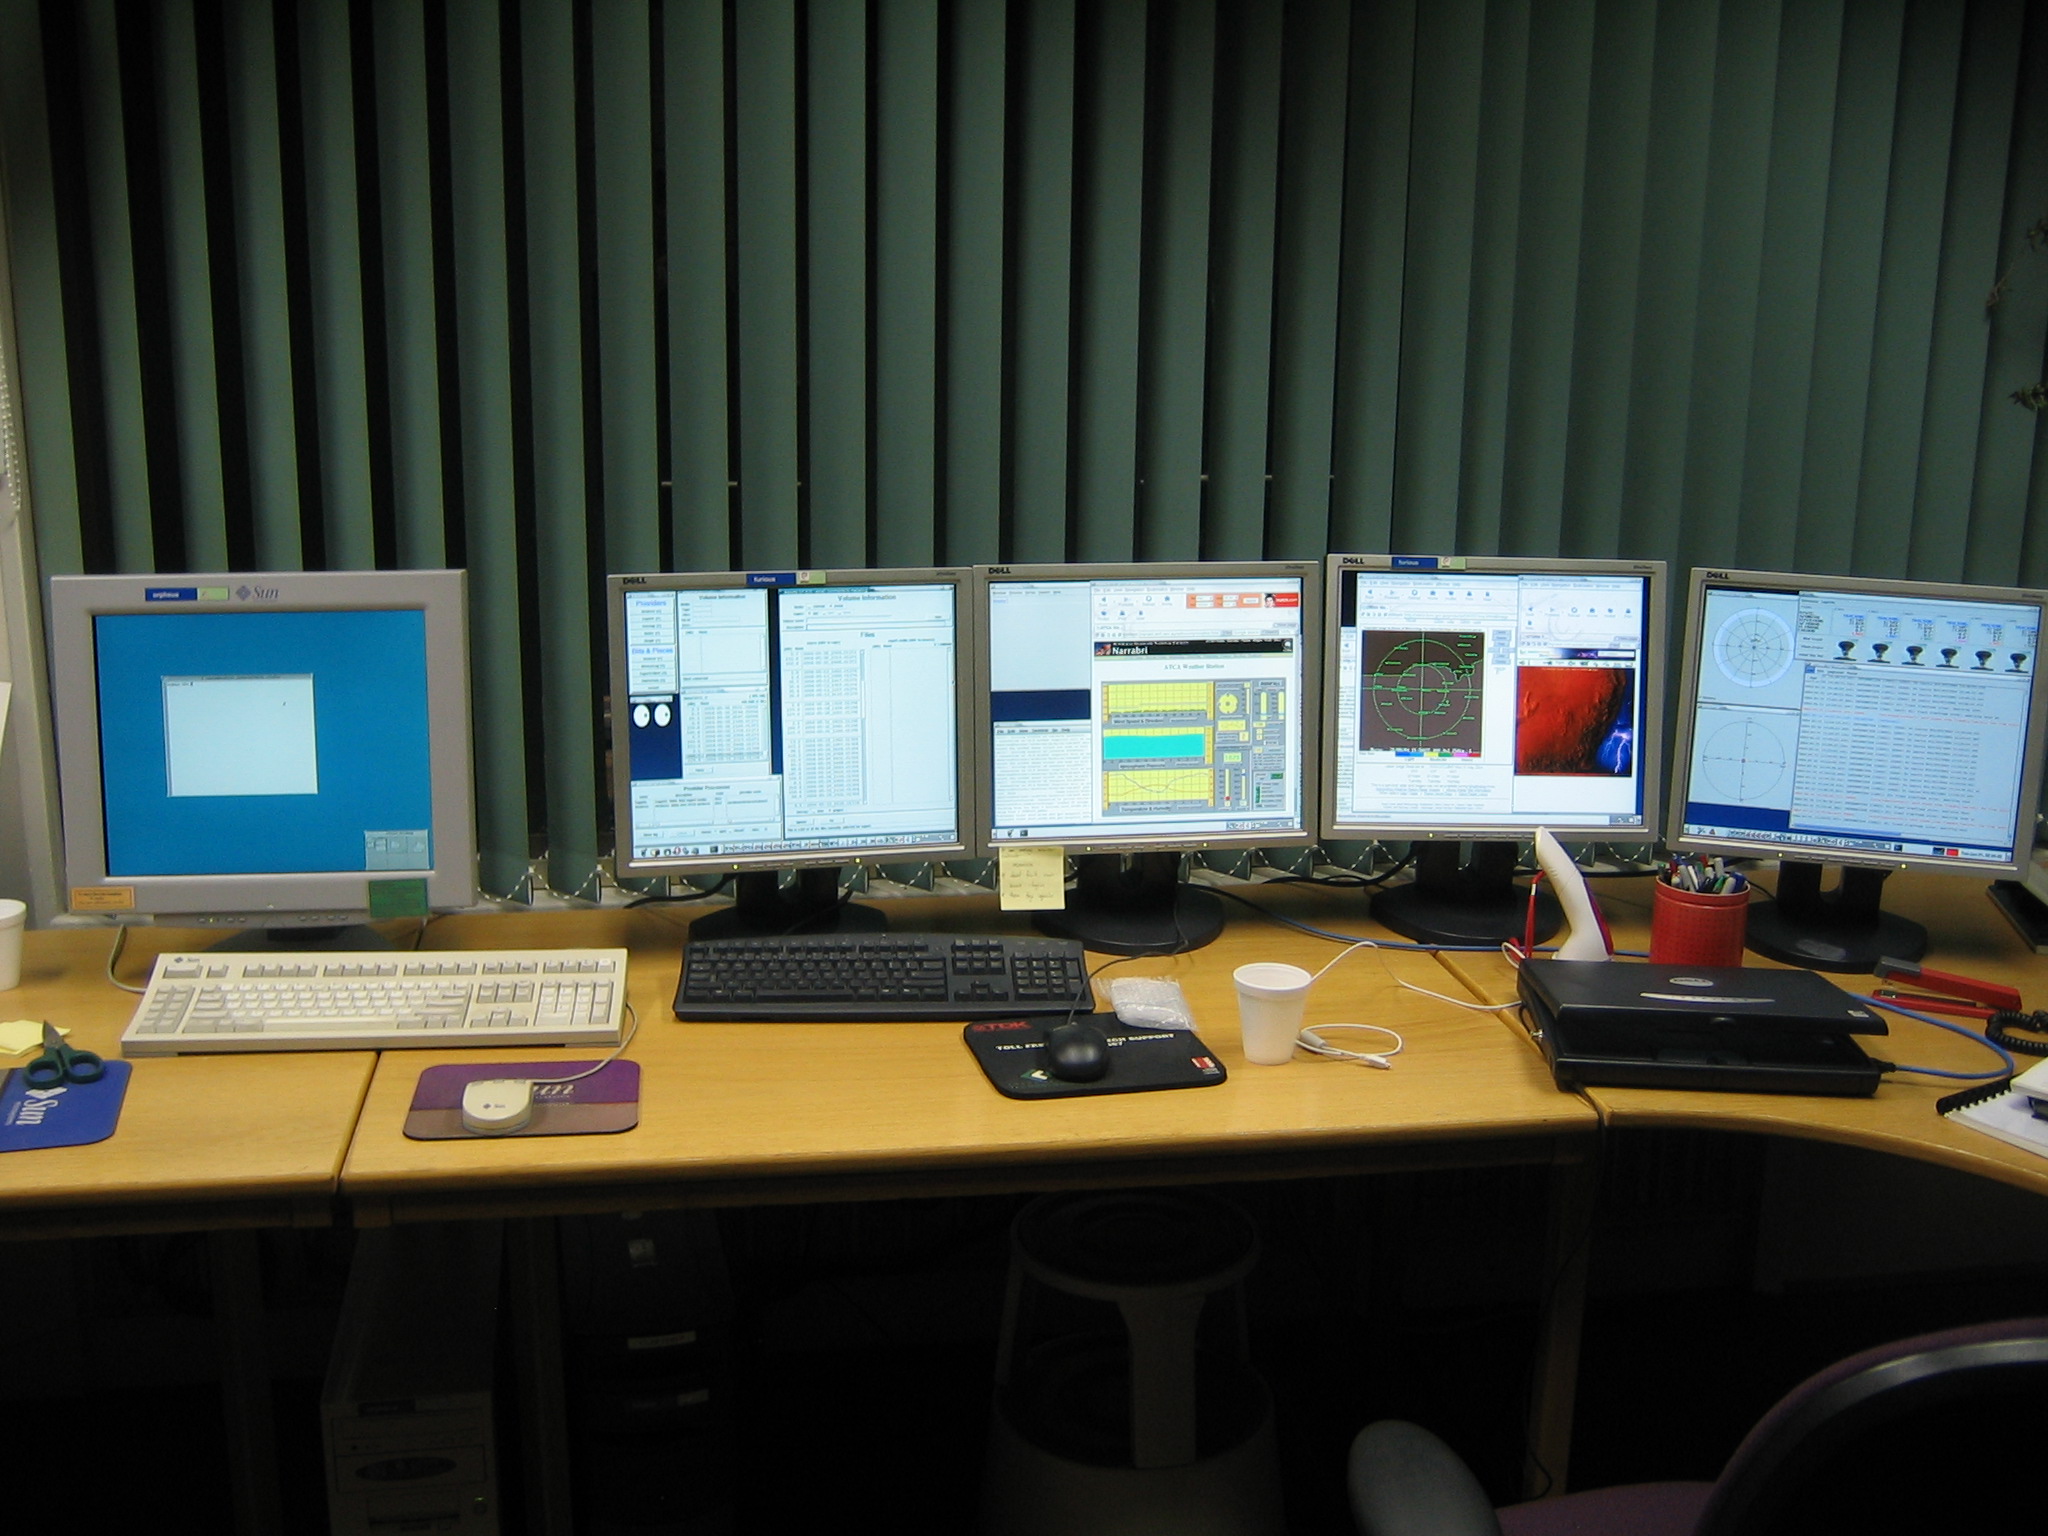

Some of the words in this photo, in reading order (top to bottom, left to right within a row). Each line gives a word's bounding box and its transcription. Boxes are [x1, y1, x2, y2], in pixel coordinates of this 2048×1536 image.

[1342, 557, 1365, 565] DELL
[988, 567, 1011, 575] DELL
[1706, 571, 1729, 580] DELL
[622, 577, 647, 585] DELL
[253, 585, 280, 600] Sun
[1112, 646, 1148, 655] Narrabri
[15, 1099, 59, 1125] Sun
